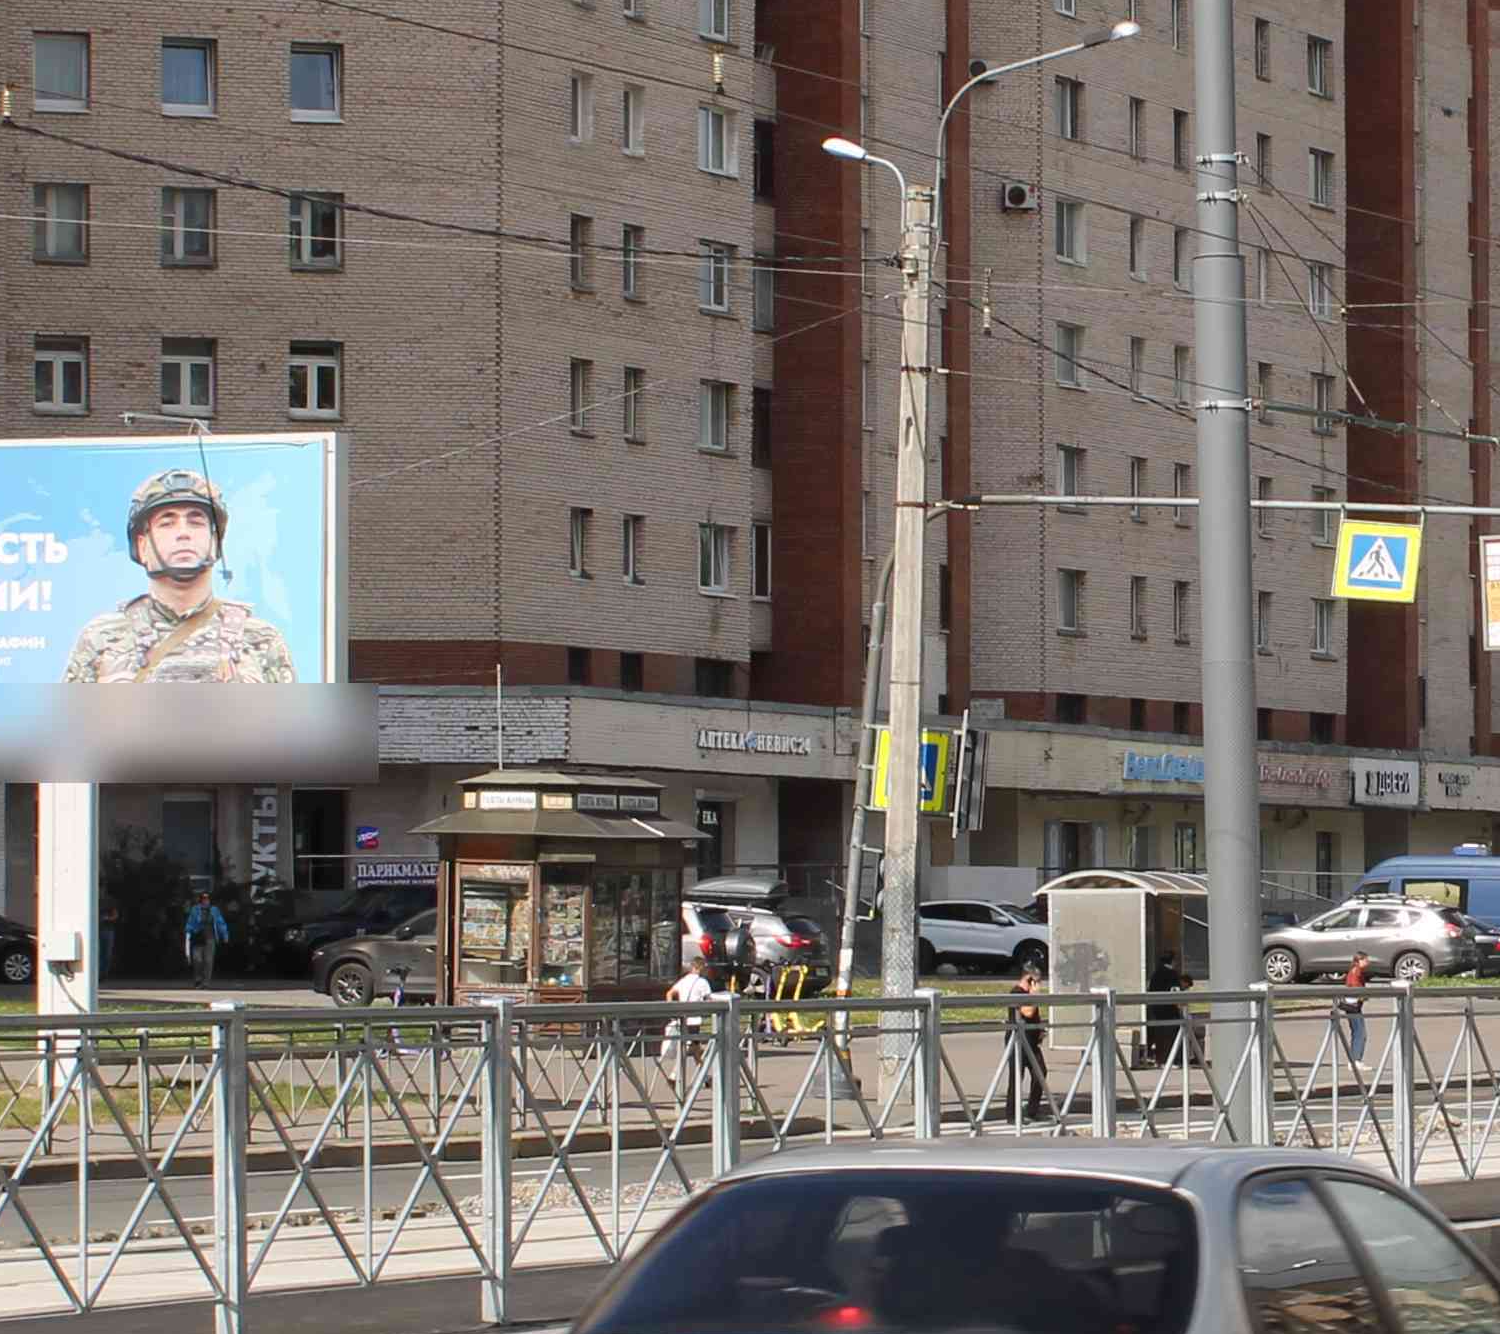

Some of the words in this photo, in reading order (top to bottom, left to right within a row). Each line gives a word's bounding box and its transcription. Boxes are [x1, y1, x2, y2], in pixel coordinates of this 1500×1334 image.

[698, 730, 746, 750] АПТЕКА
[1379, 771, 1411, 796] ДВЕРИ
[357, 863, 438, 879] ПАРИКМАХЕ
